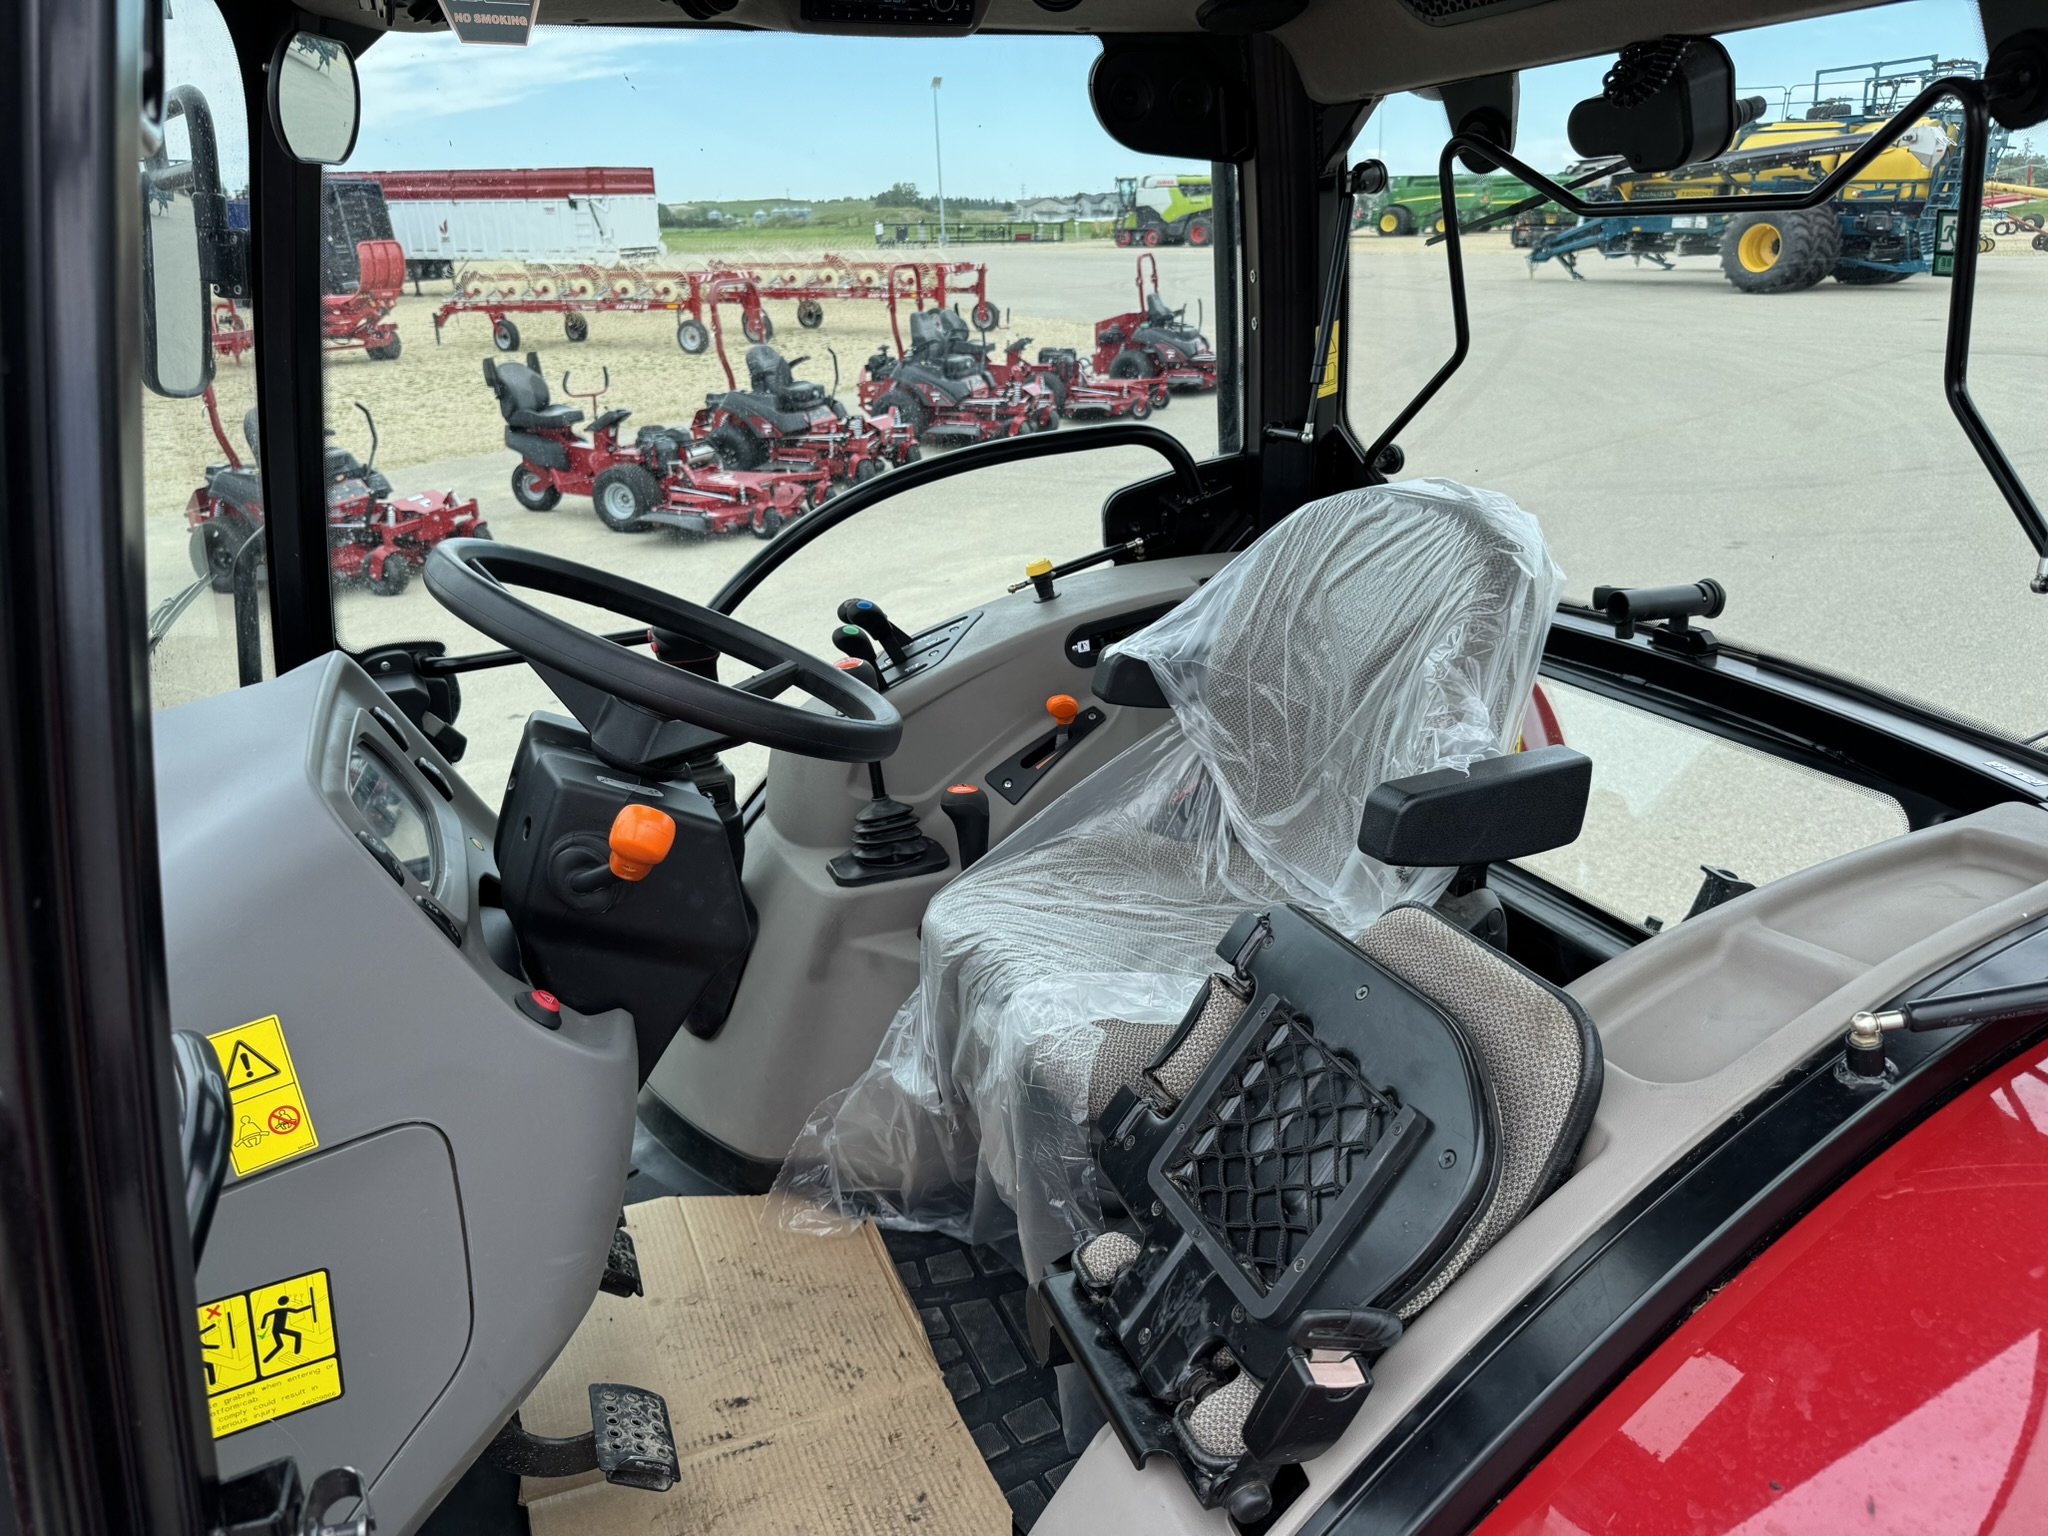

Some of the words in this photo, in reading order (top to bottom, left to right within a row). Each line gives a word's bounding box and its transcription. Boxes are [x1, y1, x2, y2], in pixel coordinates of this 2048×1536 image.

[453, 12, 472, 23] NO
[473, 13, 529, 26] SMOKING
[223, 1388, 256, 1405] grabrail
[261, 1380, 282, 1392] when
[287, 1367, 321, 1383] entering
[218, 1408, 248, 1423] comply
[253, 1398, 277, 1411] could
[281, 1387, 306, 1402] result
[216, 1417, 248, 1432] serious
